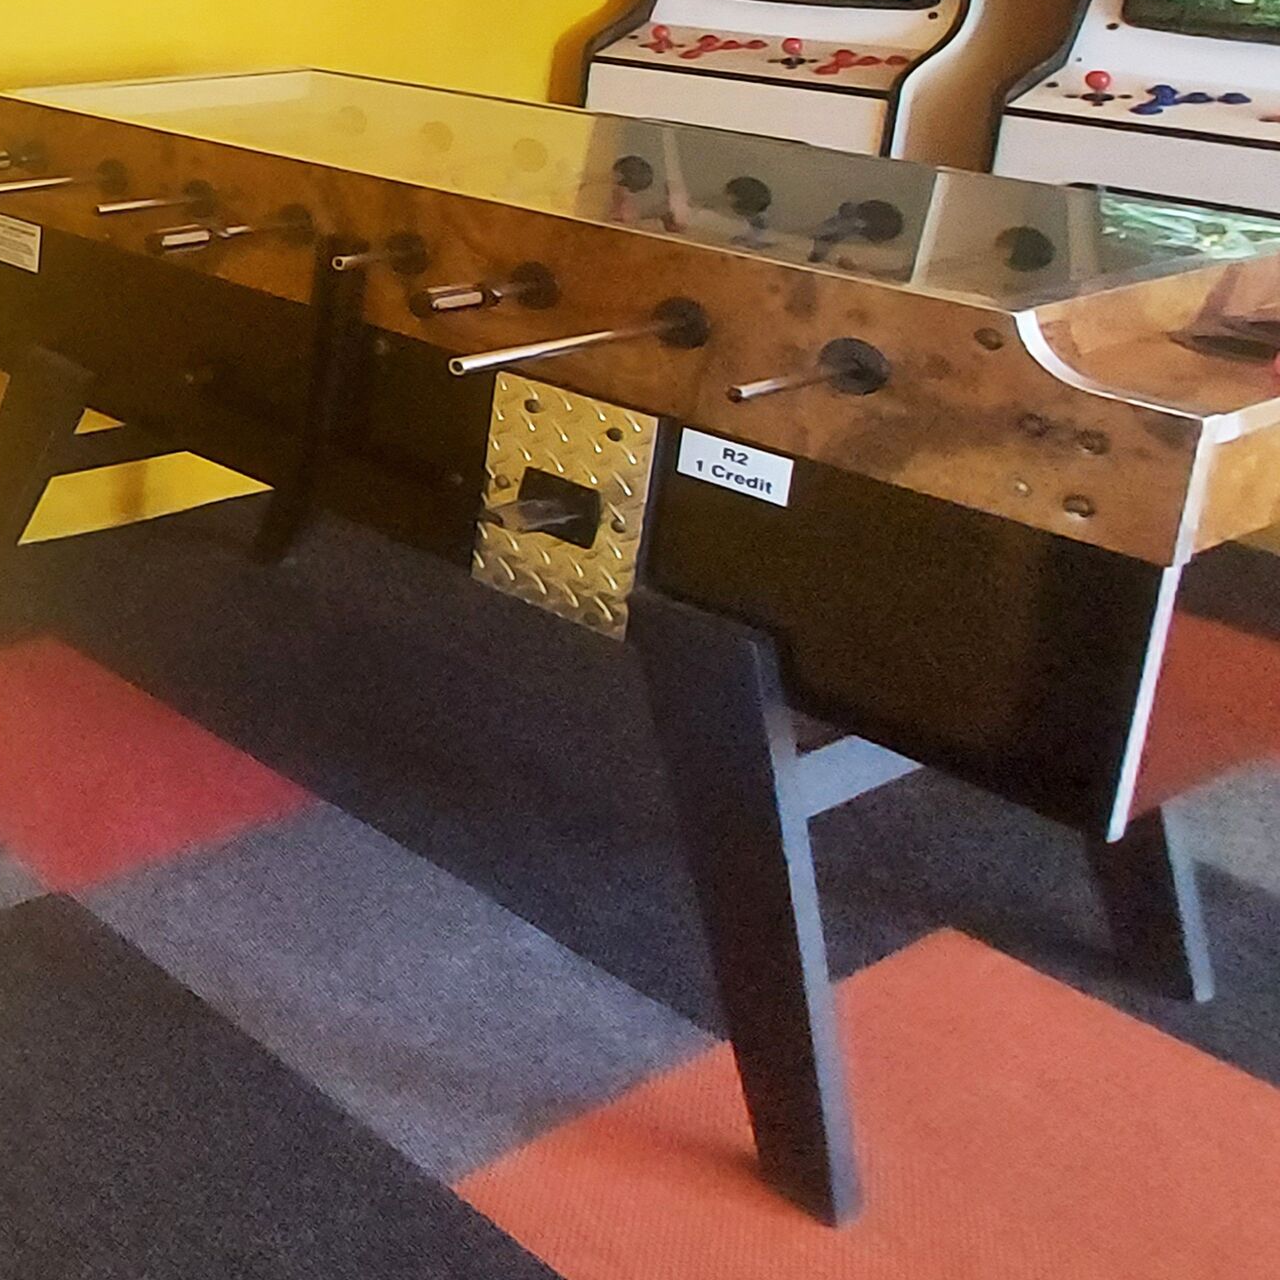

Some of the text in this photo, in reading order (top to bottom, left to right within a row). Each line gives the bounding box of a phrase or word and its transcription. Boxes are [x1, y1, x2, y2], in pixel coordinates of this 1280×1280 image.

[722, 447, 749, 466] R2
[696, 460, 773, 494] 1 Credit
